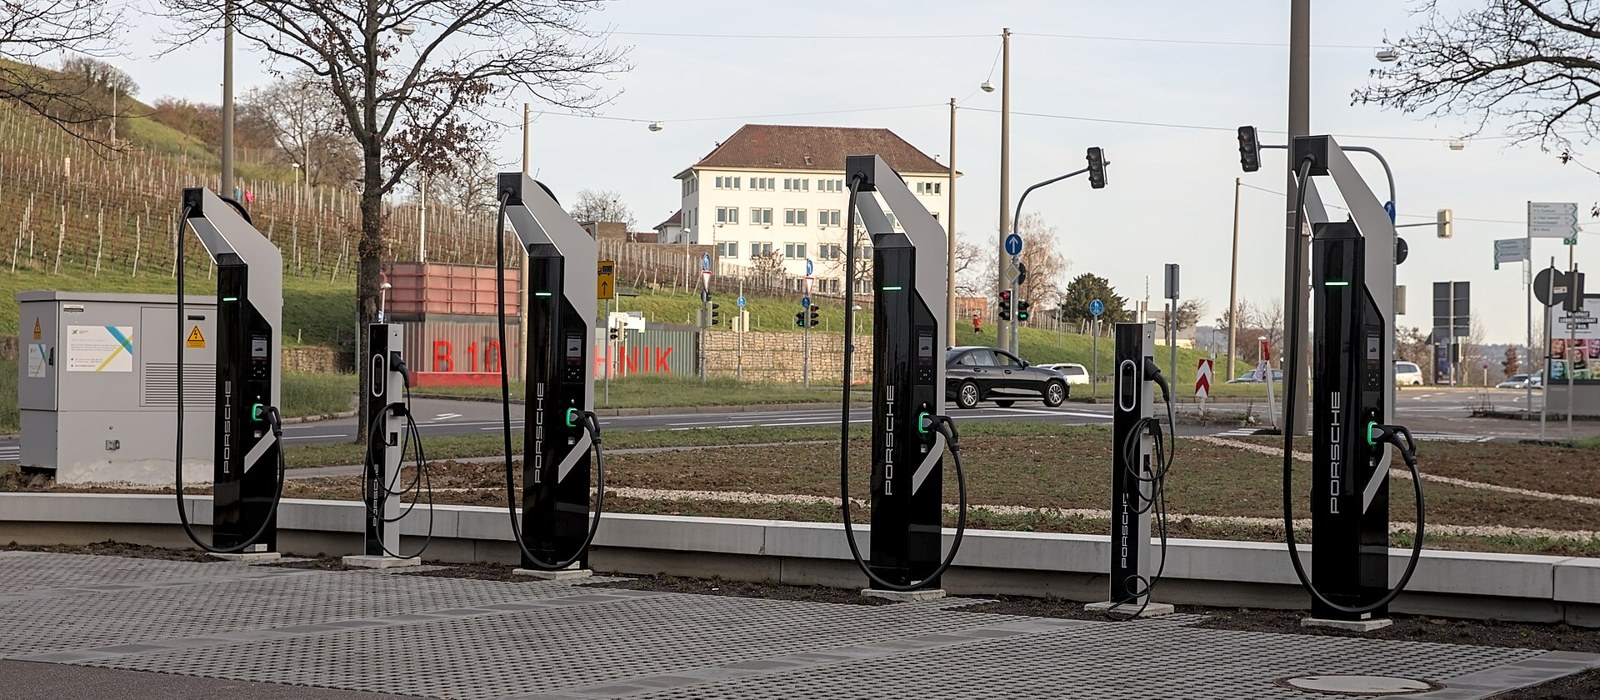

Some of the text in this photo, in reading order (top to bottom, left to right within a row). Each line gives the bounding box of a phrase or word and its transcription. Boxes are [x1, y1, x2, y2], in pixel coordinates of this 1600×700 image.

[433, 340, 454, 372] B
[593, 344, 673, 377] HNIK
[535, 382, 544, 484] PORSCHE
[885, 385, 894, 496] PORSCHE
[1331, 391, 1340, 514] PORSCHE
